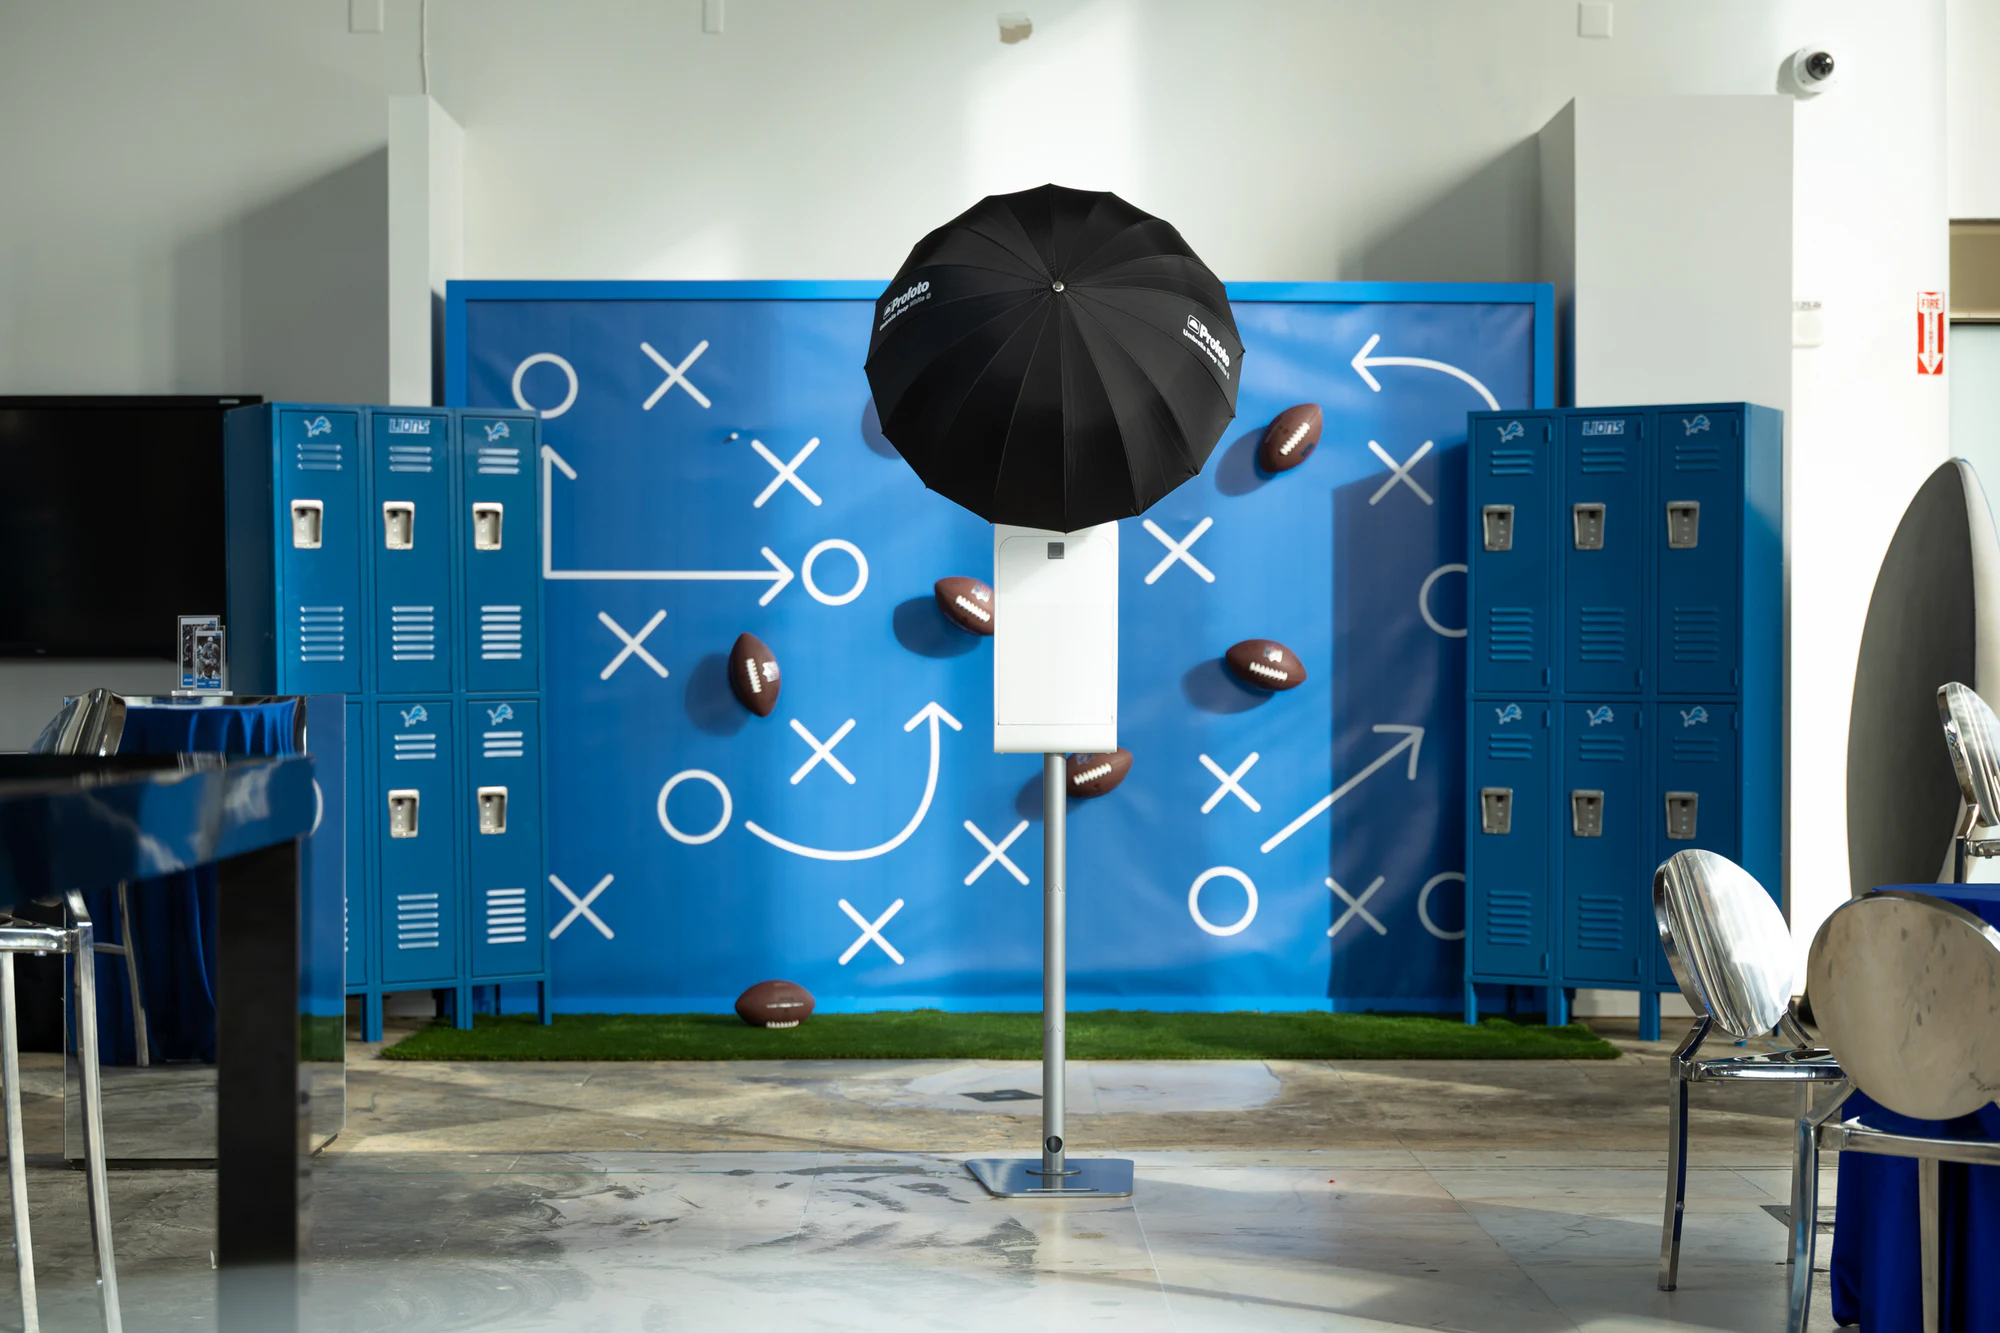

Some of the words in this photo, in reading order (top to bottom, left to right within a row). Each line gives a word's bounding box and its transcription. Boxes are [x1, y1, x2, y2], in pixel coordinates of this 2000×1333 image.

[891, 281, 930, 312] Profoto
[1921, 298, 1940, 310] FIRE
[1200, 323, 1230, 367] Profoto
[388, 418, 431, 434] LIONS
[1581, 419, 1625, 436] LIONS
